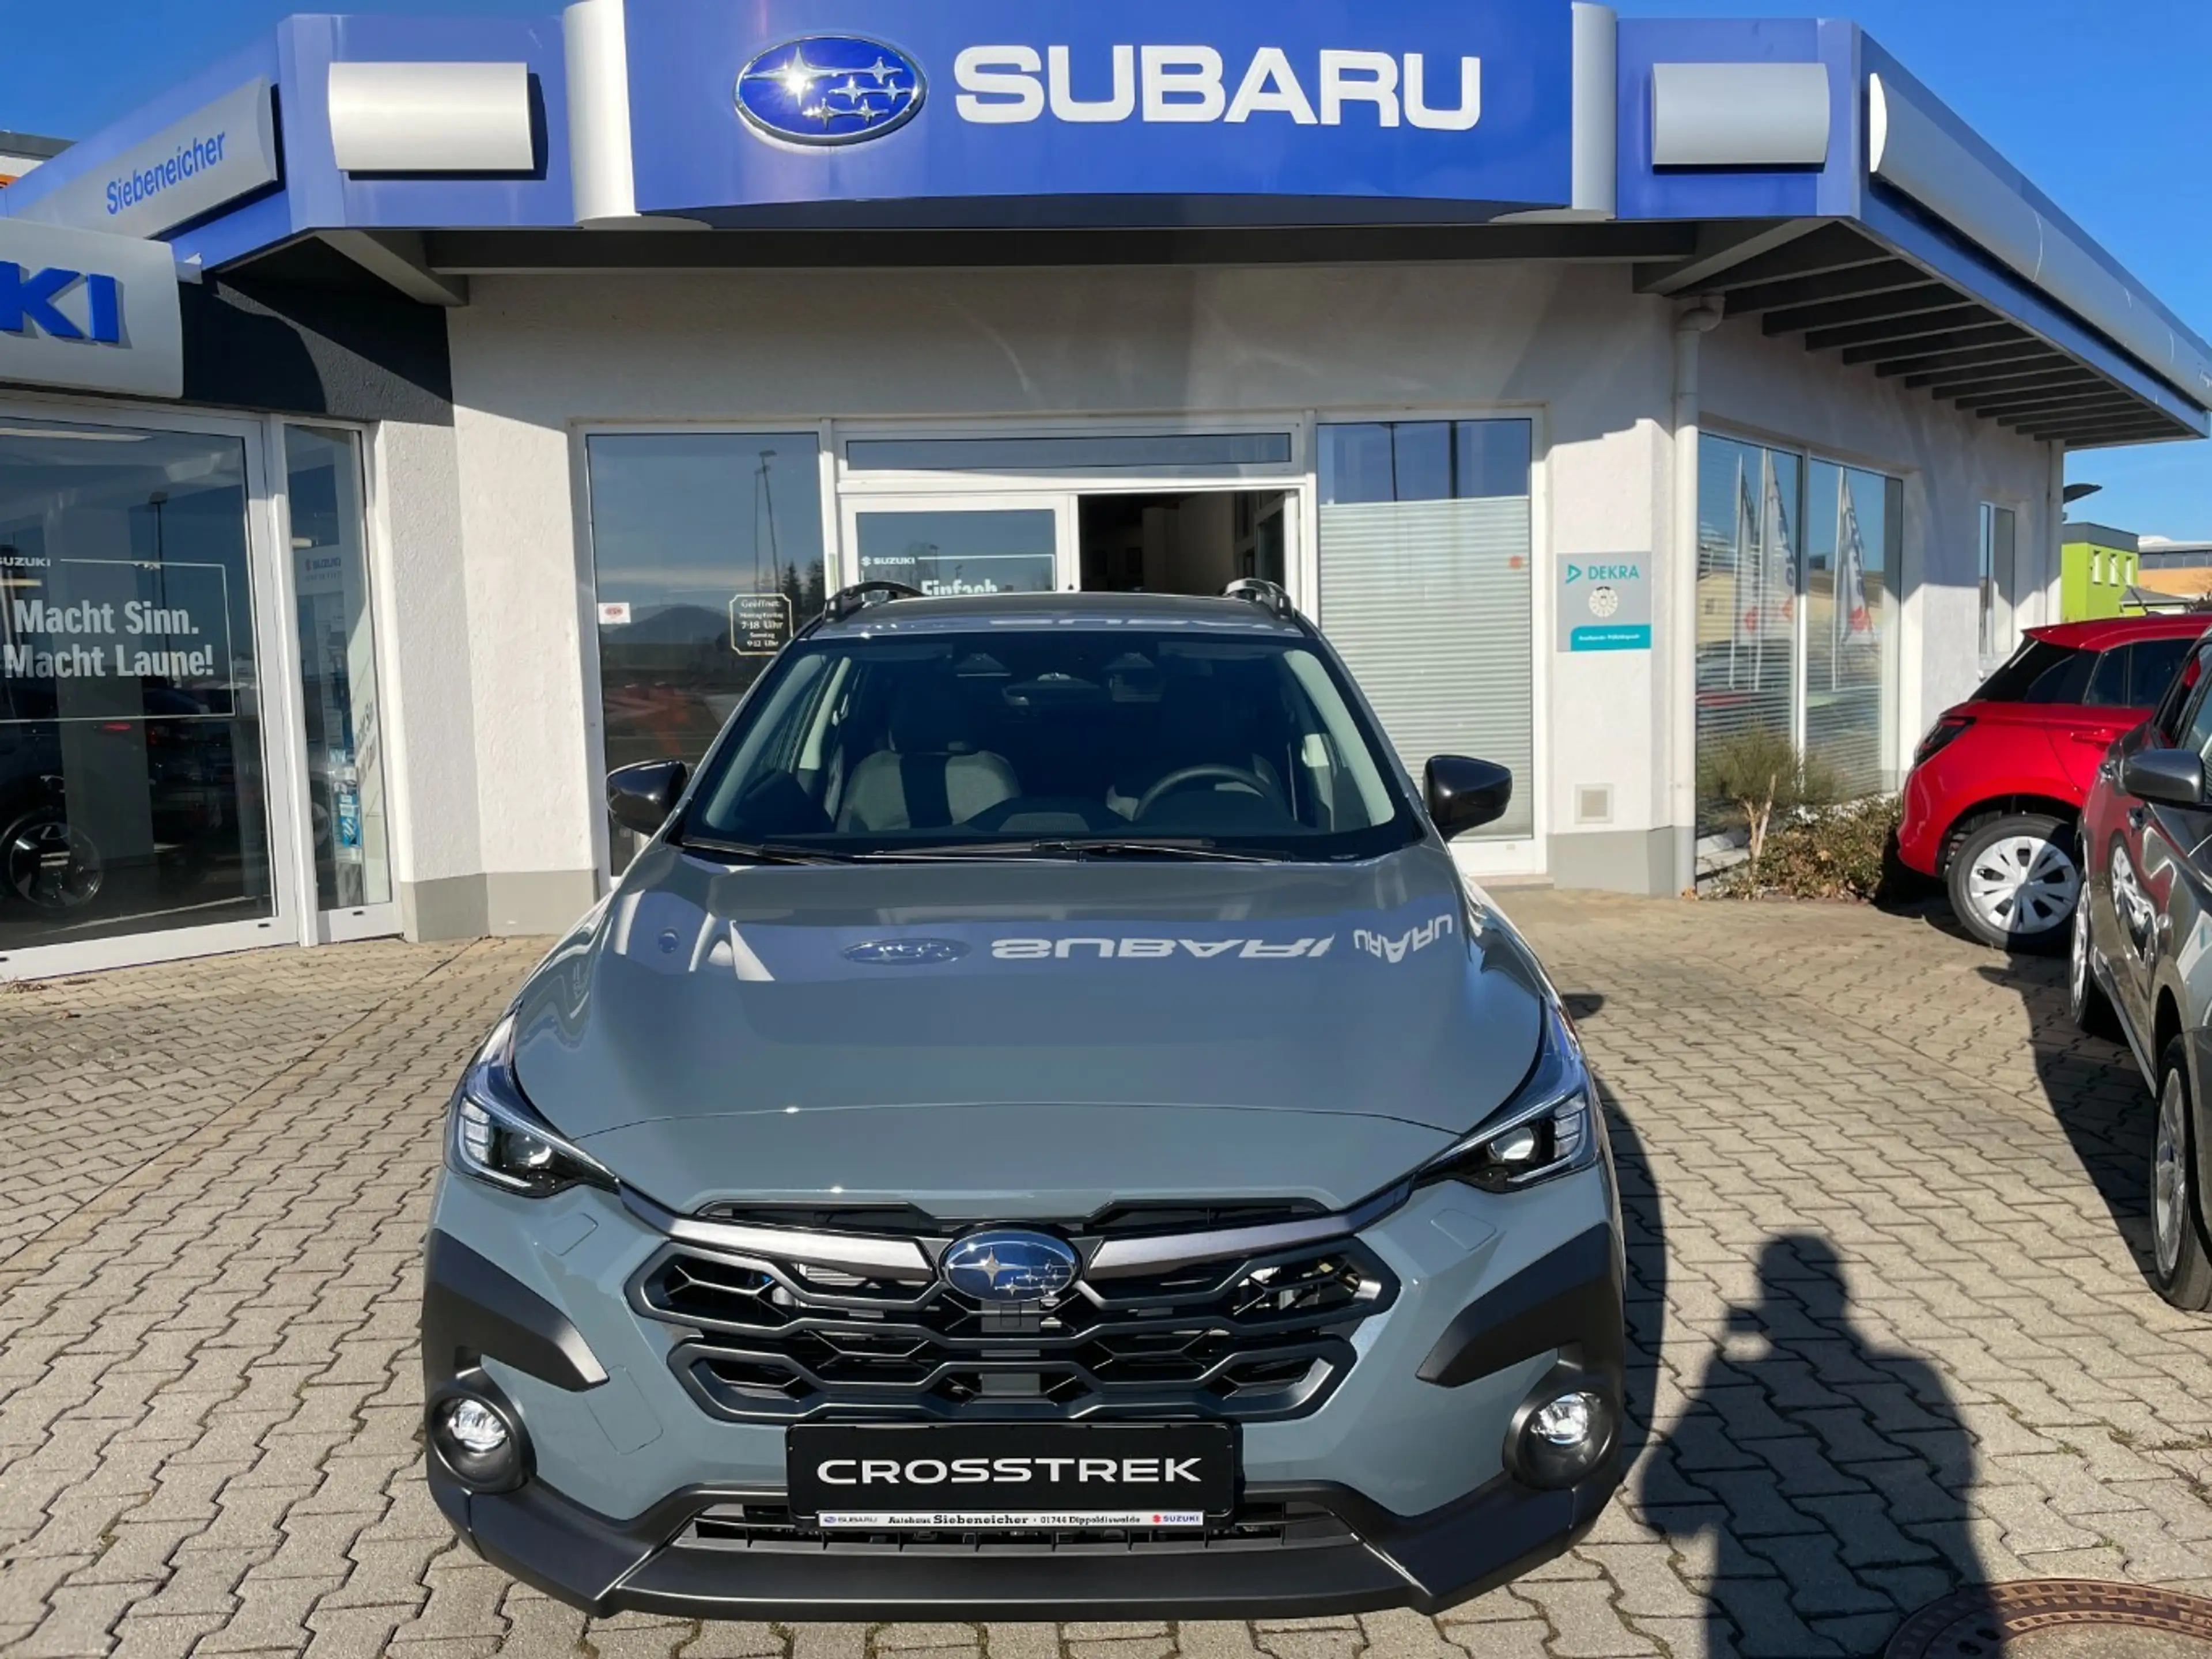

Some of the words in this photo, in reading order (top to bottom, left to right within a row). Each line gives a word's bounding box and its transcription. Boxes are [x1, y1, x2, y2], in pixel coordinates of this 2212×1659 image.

[954, 45, 1481, 130] SUBARU
[106, 131, 226, 215] Siebeneicher
[0, 556, 51, 567] UZUKI
[873, 556, 915, 565] SUZUKI
[1588, 565, 1640, 580] DEKRA
[14, 600, 115, 634] Macht
[124, 601, 199, 634] Sinn.
[3, 645, 105, 677] Macht
[115, 645, 214, 676] Laune!
[817, 1457, 1203, 1484] CROSSTREK
[933, 1514, 1029, 1525] Siebeneicher
